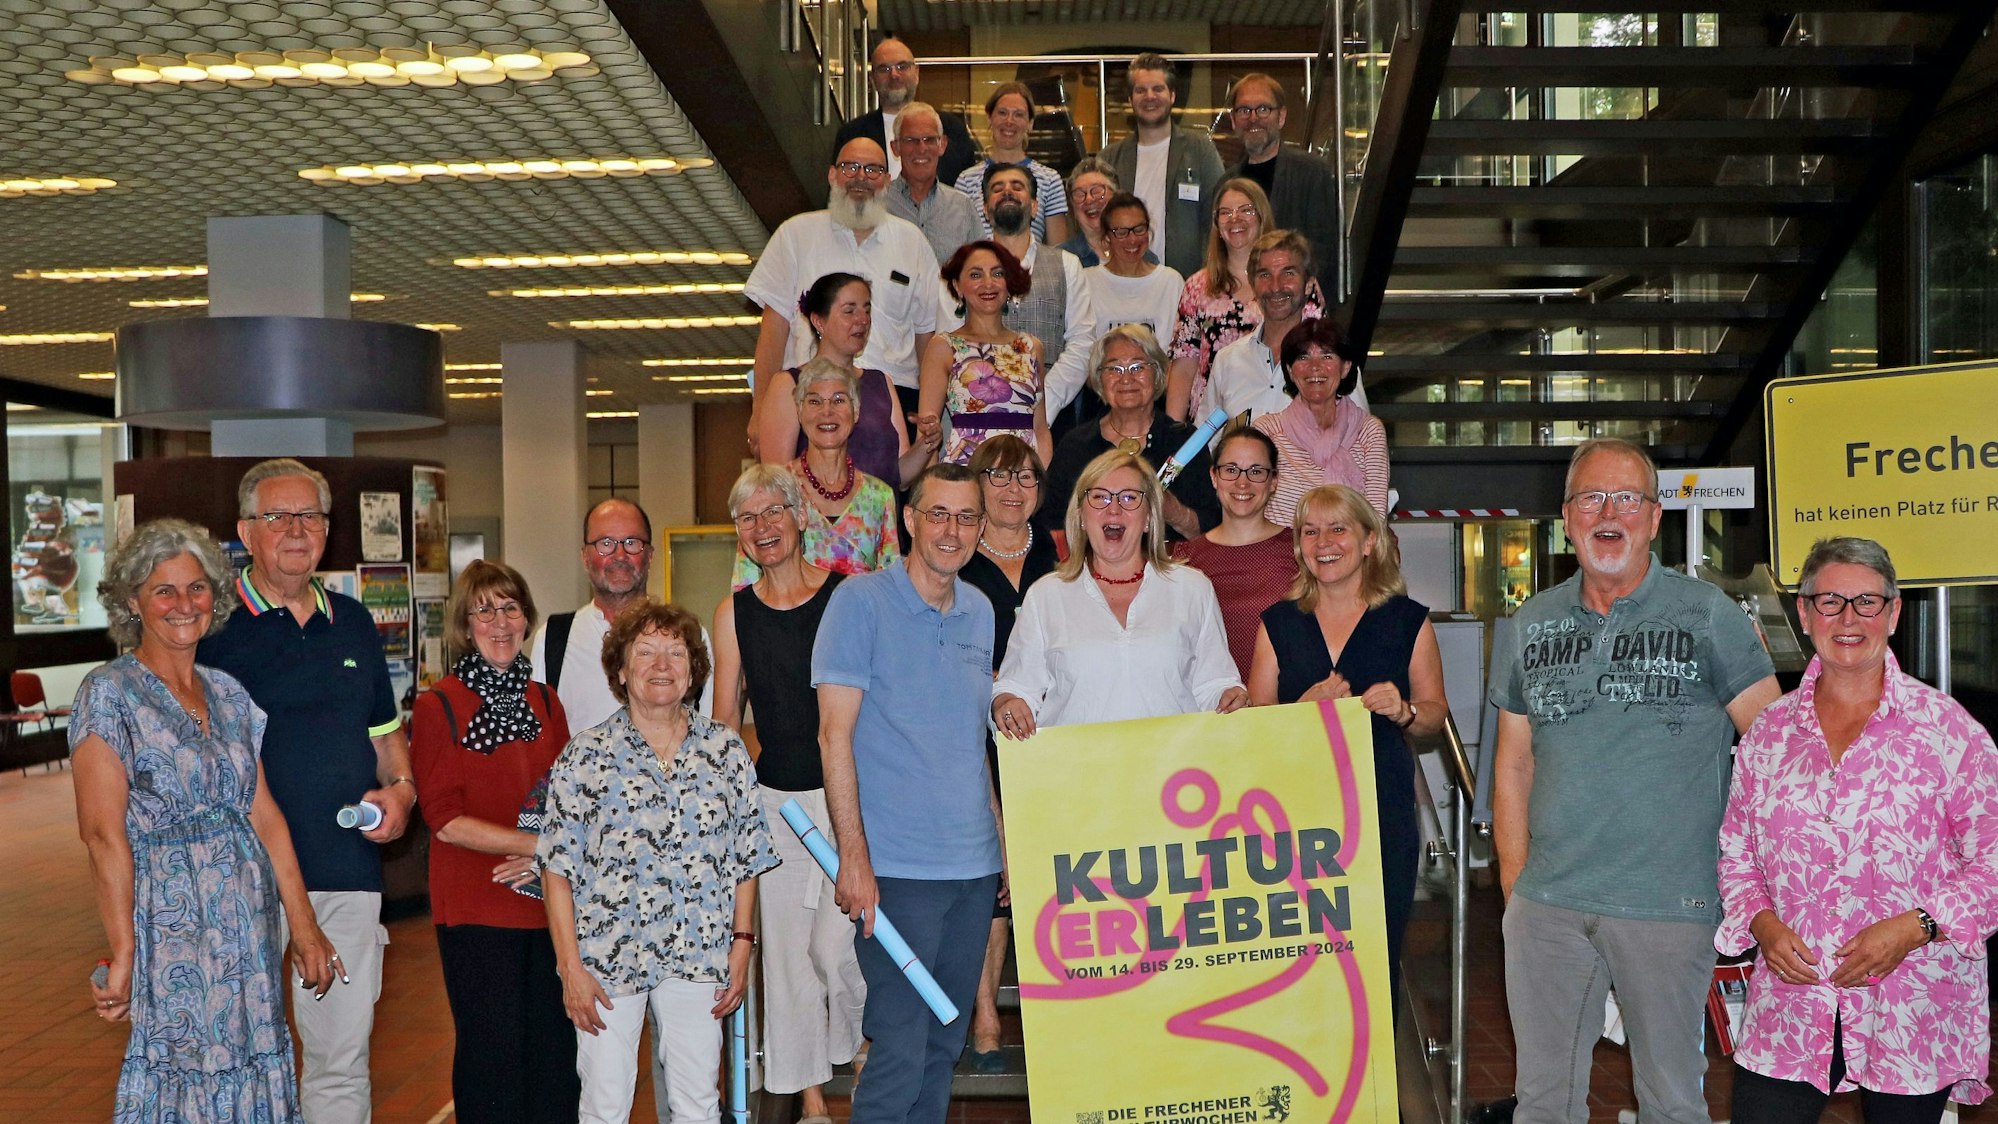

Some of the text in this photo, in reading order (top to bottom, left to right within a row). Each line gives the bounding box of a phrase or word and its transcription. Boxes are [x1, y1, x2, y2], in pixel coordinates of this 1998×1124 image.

[1846, 435, 1998, 477] Freche
[1694, 487, 1745, 498] FRECHEN
[1795, 507, 1823, 523] hat
[1829, 504, 1891, 521] keinen
[1897, 500, 1945, 517] Platz
[1952, 497, 1980, 514] für
[1523, 637, 1593, 672] CAMP
[1611, 629, 1695, 663] DAVID
[1526, 666, 1585, 681] TROPICAL
[1054, 828, 1347, 905] KULTUR
[1057, 886, 1352, 959] ERLEBEN
[1065, 940, 1355, 980] VOM 14. BIS 29. SEPTEMBER 2024
[1108, 1096, 1252, 1121] DIE FRECHENER
